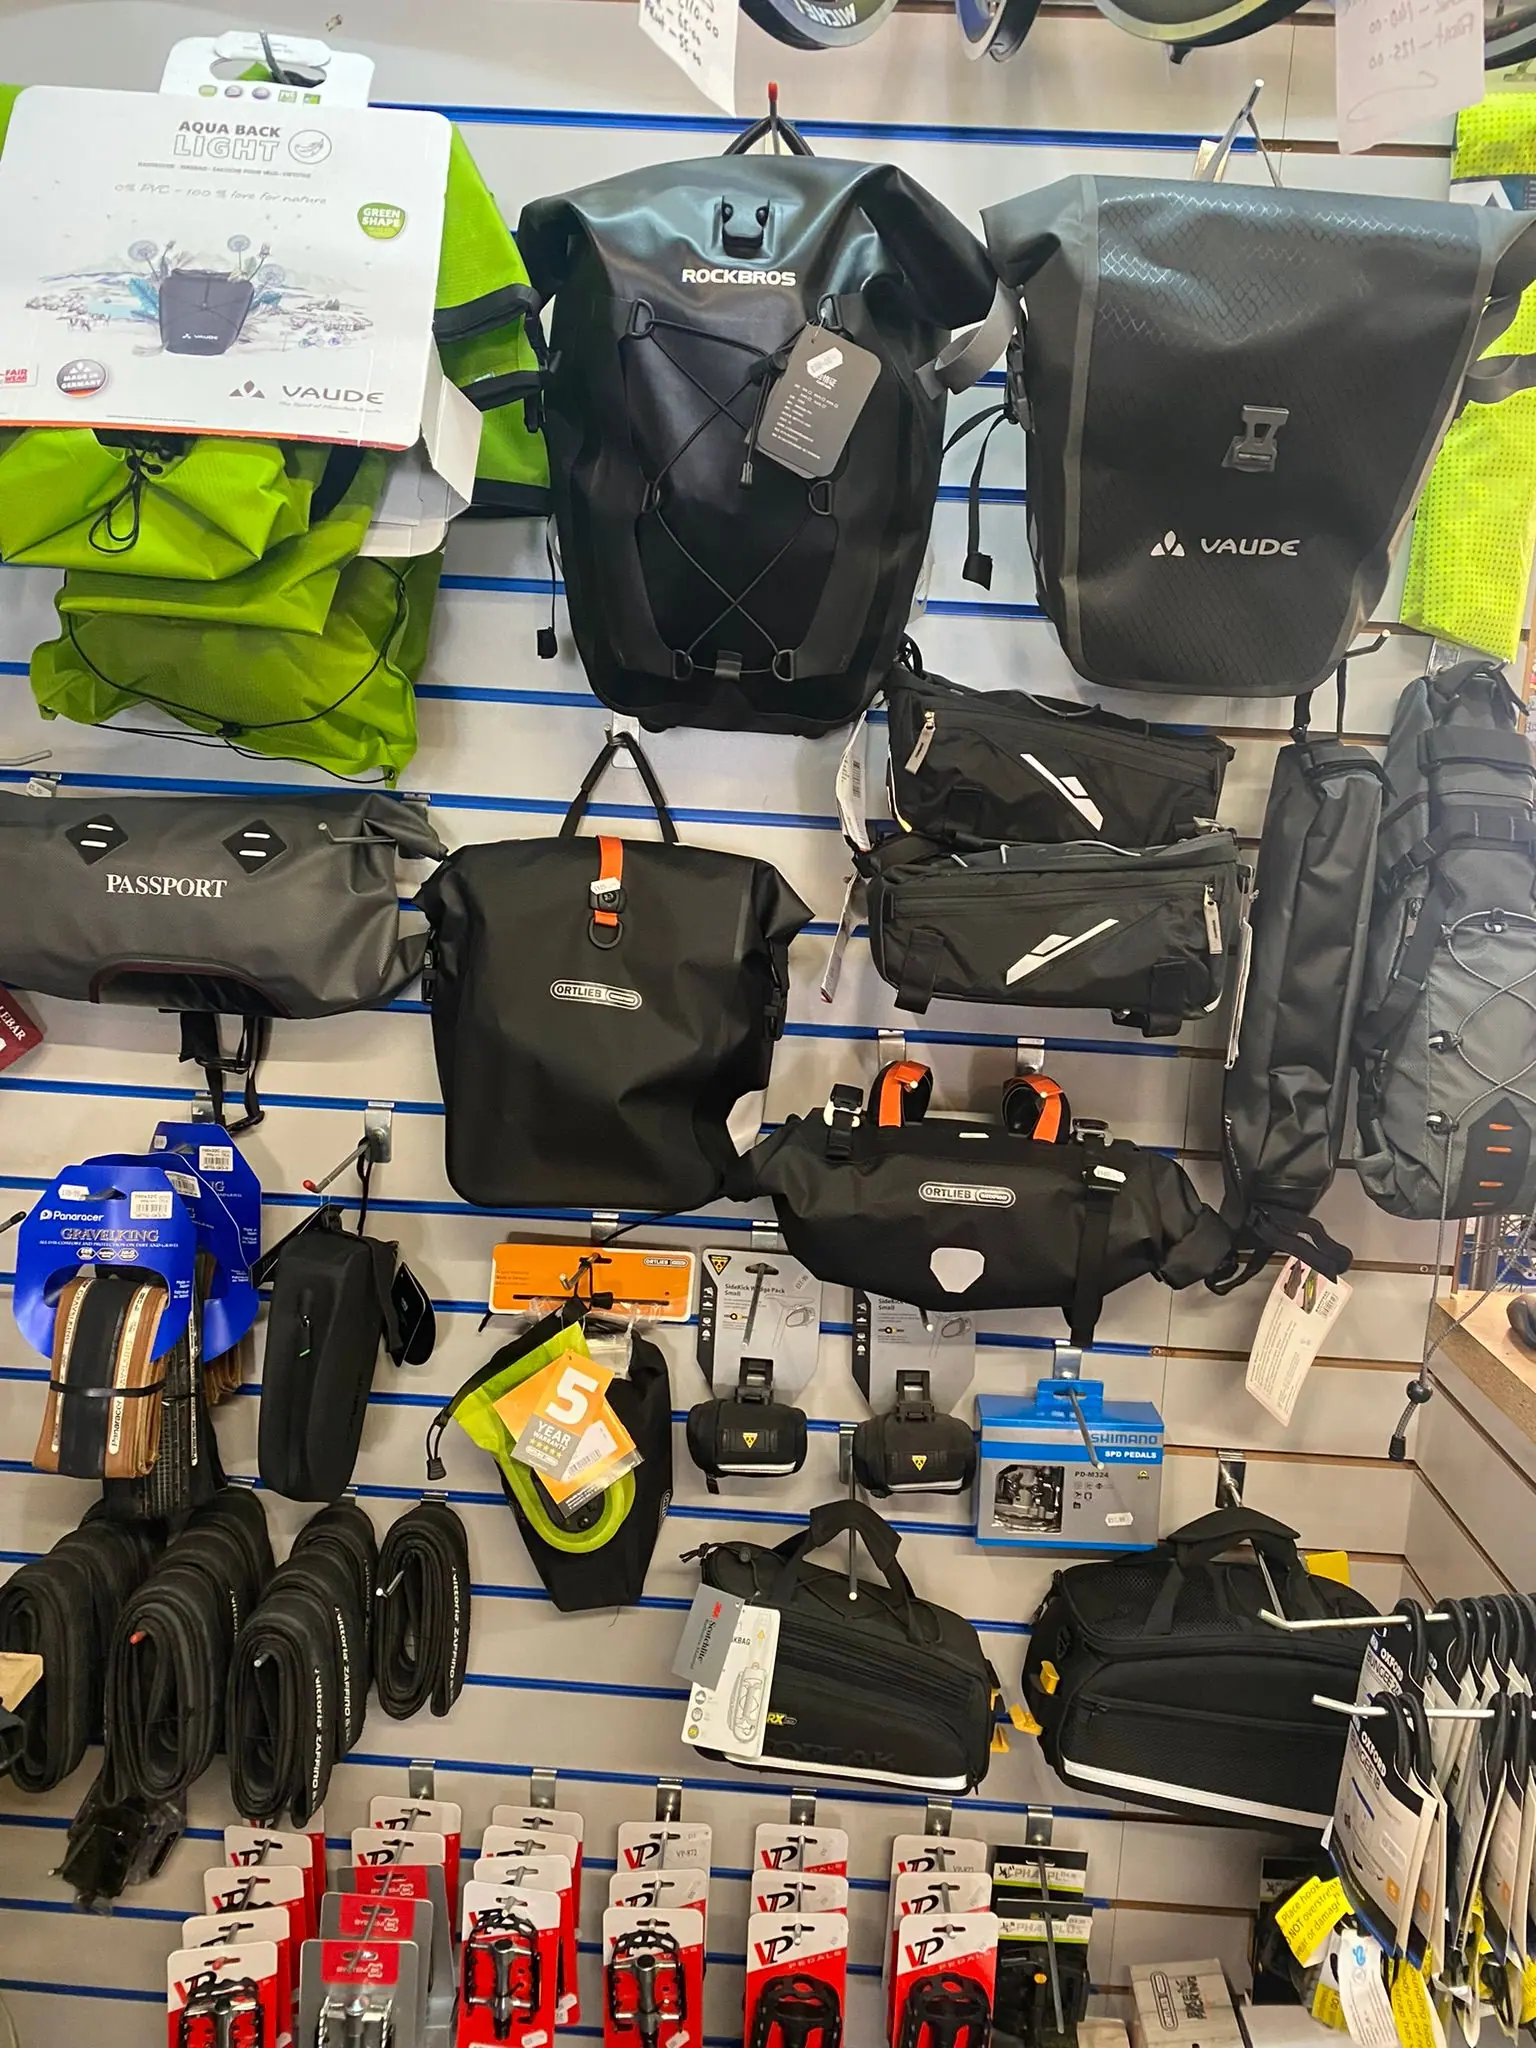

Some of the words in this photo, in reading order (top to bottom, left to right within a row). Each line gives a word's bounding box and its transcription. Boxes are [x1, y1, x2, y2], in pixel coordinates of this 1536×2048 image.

[178, 121, 230, 135] AQUA
[235, 125, 281, 138] BACK
[173, 134, 281, 162] LIGHT
[139, 184, 171, 195] PVC
[186, 188, 212, 198] 100
[230, 190, 256, 201] love
[260, 192, 282, 203] for
[281, 194, 327, 206] nature
[361, 216, 401, 228] SHAPE
[363, 207, 401, 219] GREEN
[681, 268, 797, 287] ROCKBROS
[4, 375, 28, 383] WEAR
[5, 368, 28, 376] FAIR
[62, 374, 87, 382] MADE
[60, 380, 101, 390] GERMANY
[282, 385, 385, 405] VAUDE
[1200, 537, 1301, 557] VAUDE
[105, 873, 228, 899] PASSPORT
[555, 982, 603, 1000] ORTLIEB
[925, 1186, 972, 1201] ORTLIEB
[53, 1209, 104, 1222] Panaracer
[60, 1227, 160, 1243] GRAVELKING
[724, 1283, 749, 1292] SideKick
[750, 1285, 771, 1294] Wdge
[771, 1287, 786, 1295] Pack
[724, 1289, 741, 1297] Small
[545, 1366, 599, 1425] 5
[532, 1430, 568, 1452] WARRANTY
[536, 1419, 572, 1447] YEAR
[1090, 1433, 1158, 1445] SHIMANO
[1104, 1450, 1122, 1459] SPD
[1124, 1450, 1157, 1459] PEDALS
[1074, 1470, 1109, 1479] PD-M324
[698, 1620, 718, 1663] Scotchlite
[1366, 1652, 1396, 1688] BUNGEE
[1380, 1647, 1404, 1682] OXFORD
[1361, 1730, 1387, 1778] OXFORD
[624, 1842, 660, 1871] VP
[760, 1845, 798, 1871] VP
[758, 1891, 796, 1913] VP
[901, 1894, 939, 1917] VP
[1281, 1902, 1301, 1924] Place
[1288, 1918, 1305, 1939] NOT
[753, 1934, 795, 1967] VP
[788, 1949, 844, 1970] PEDALS
[904, 1936, 945, 1969] VP
[937, 1949, 995, 1972] PEDALS
